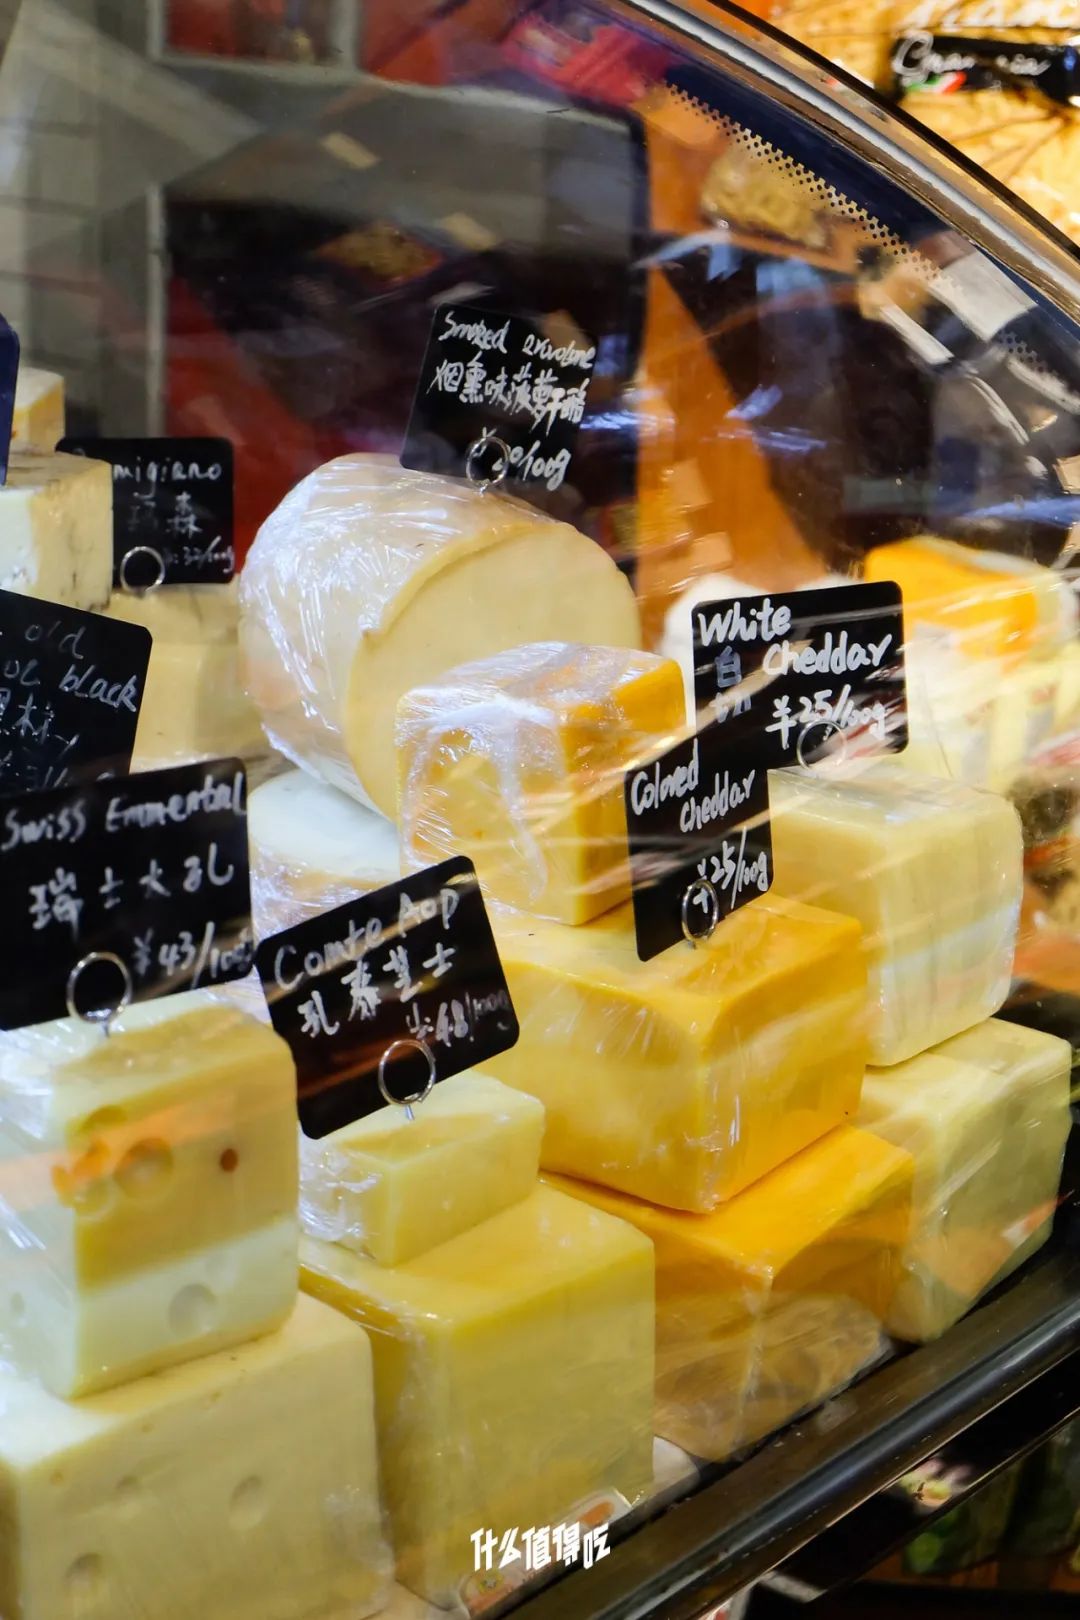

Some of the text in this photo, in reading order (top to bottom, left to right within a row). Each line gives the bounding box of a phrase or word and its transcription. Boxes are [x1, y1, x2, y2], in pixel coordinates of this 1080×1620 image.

[112, 455, 223, 499] migiano
[698, 597, 792, 647] White
[762, 630, 893, 676] Cheddar
[0, 800, 88, 851] Swiss
[273, 916, 385, 992] Comte
